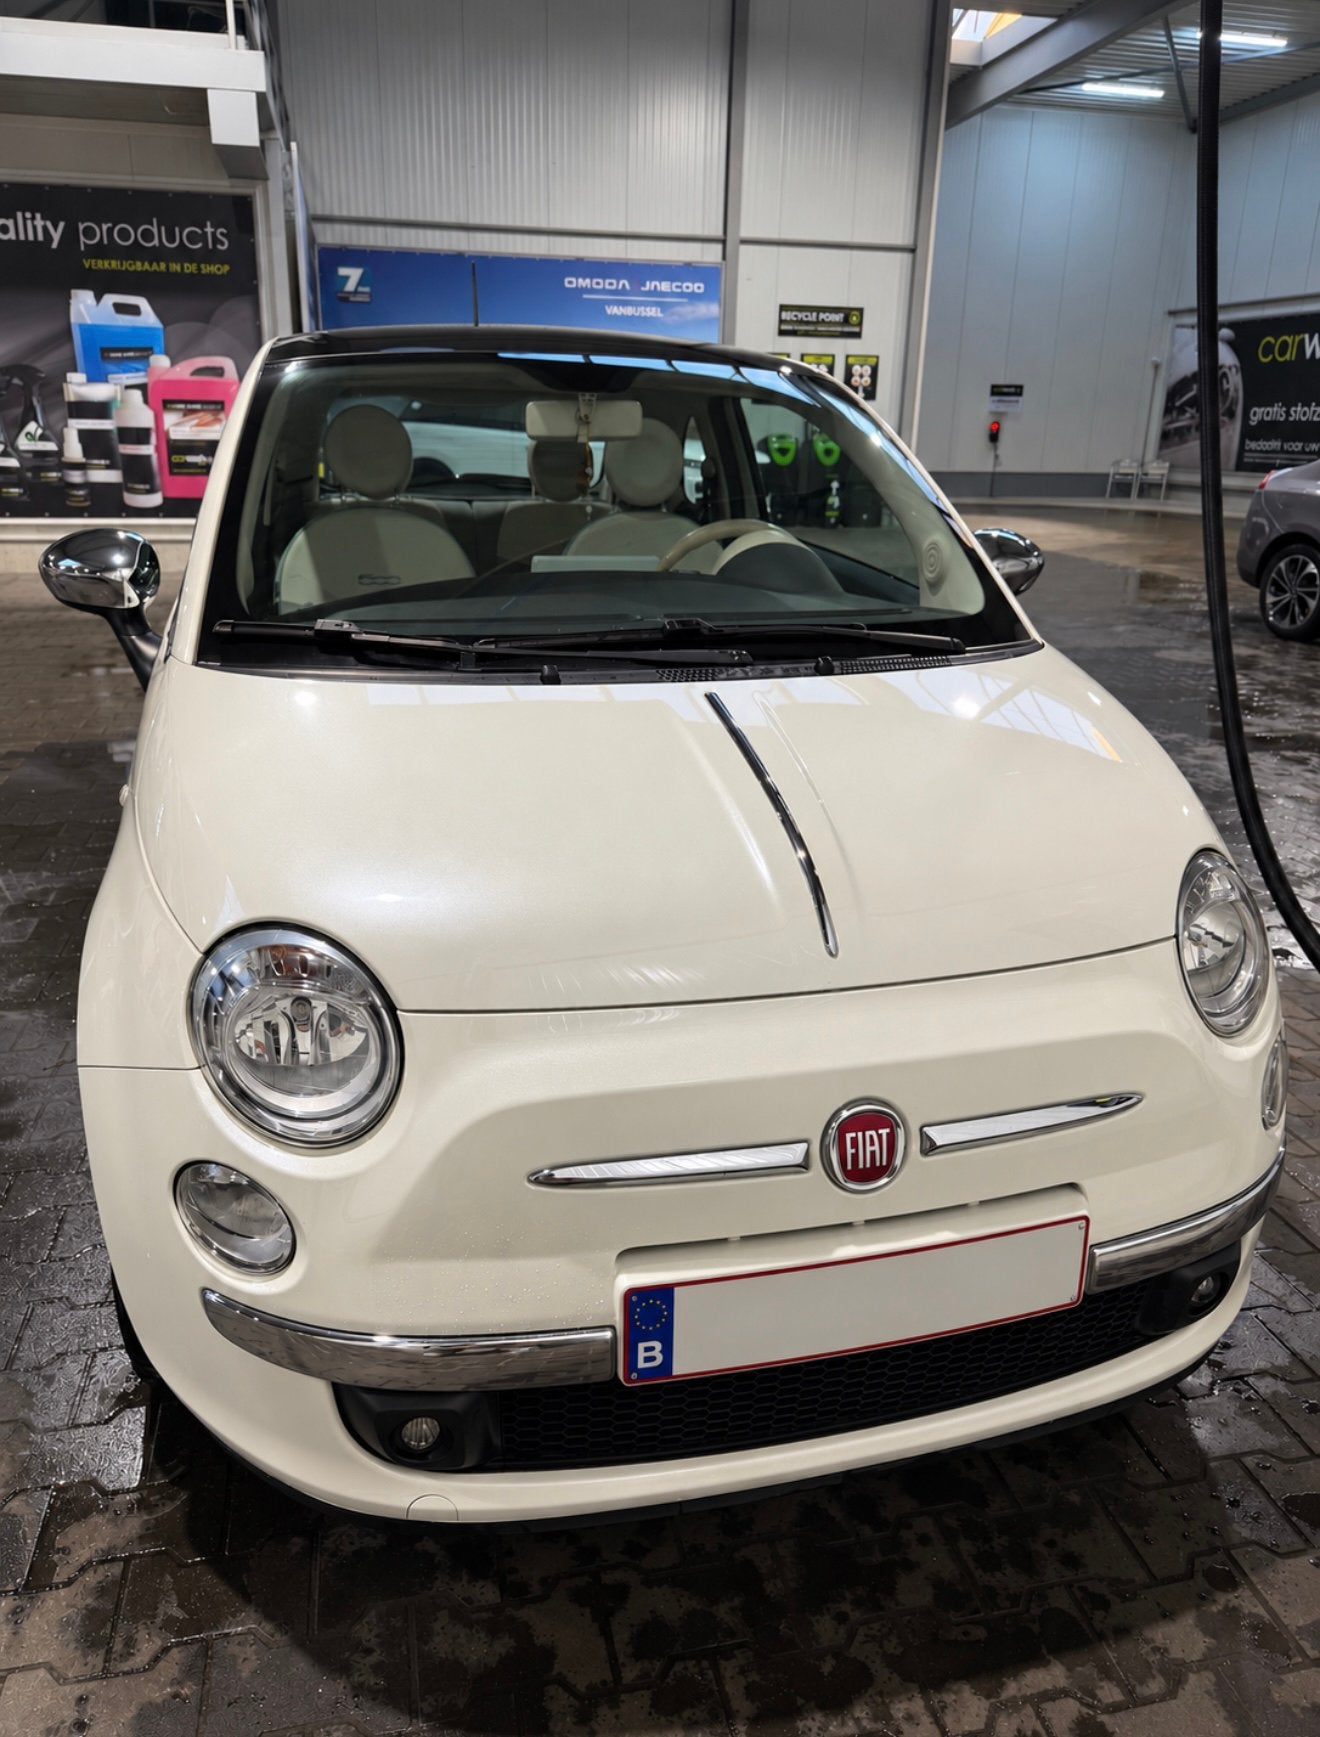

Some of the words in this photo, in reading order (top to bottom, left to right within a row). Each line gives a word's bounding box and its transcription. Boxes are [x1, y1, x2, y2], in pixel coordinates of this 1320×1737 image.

[0, 211, 66, 250] ality
[78, 218, 229, 250] products
[82, 258, 167, 272] VERKRIJGBAAR
[168, 262, 181, 273] IN
[183, 262, 199, 274] DE
[200, 263, 231, 276] SHOP
[564, 277, 630, 290] OMODA
[640, 280, 705, 293] JAECOO
[819, 312, 845, 322] POINT
[1258, 333, 1320, 362] carw
[1249, 402, 1286, 425] gratis
[845, 1127, 891, 1171] FIAT
[638, 1341, 663, 1369] B
